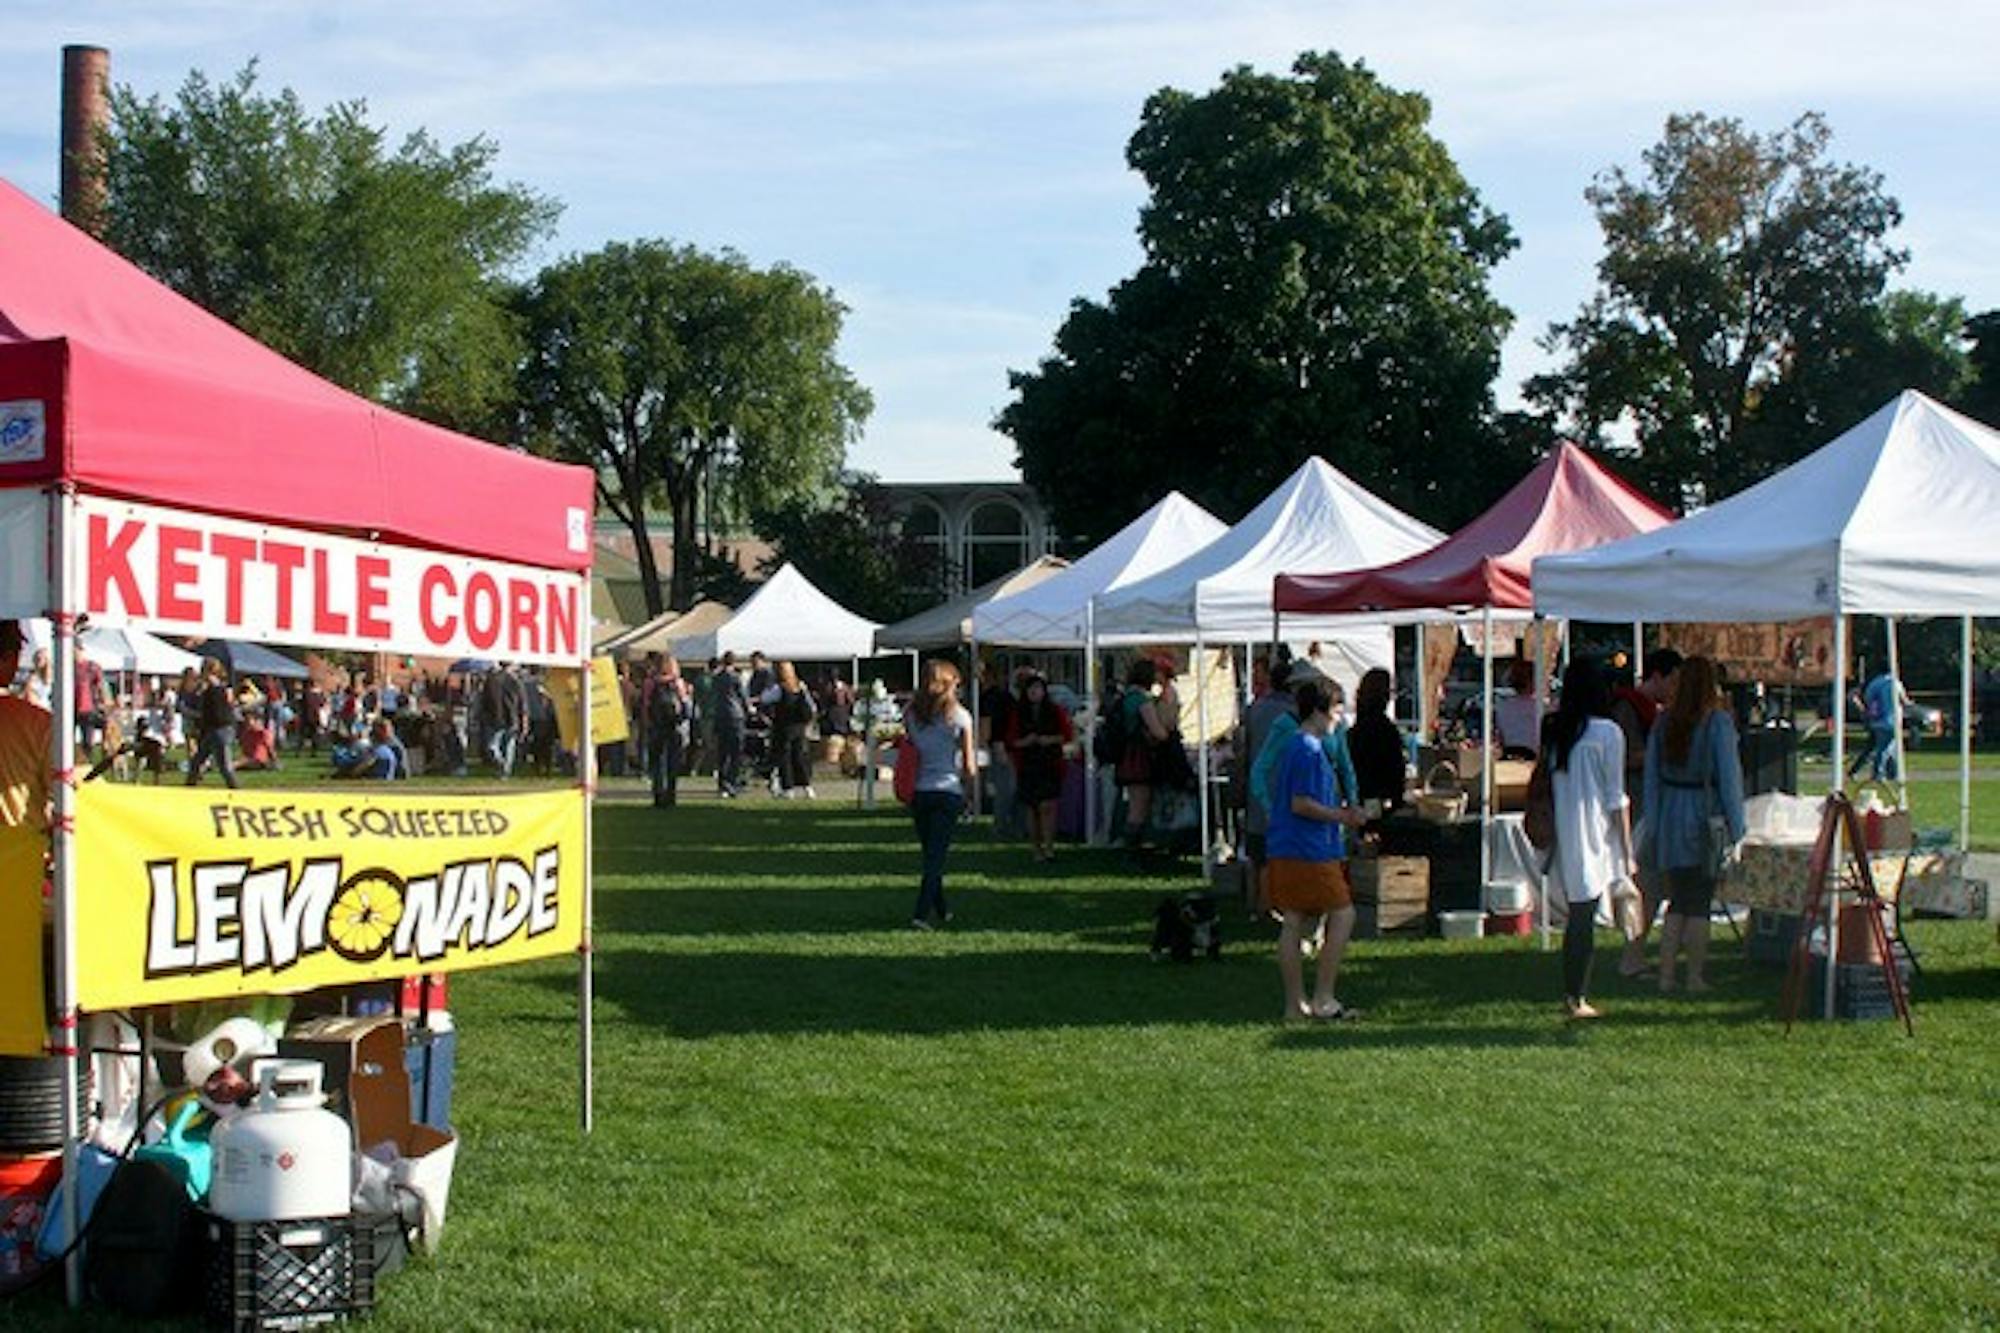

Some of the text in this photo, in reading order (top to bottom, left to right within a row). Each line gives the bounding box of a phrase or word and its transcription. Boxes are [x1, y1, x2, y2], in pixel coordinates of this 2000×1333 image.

[87, 514, 578, 654] KETTLE CORN
[211, 804, 510, 840] FRESH SQUEEZED
[144, 843, 560, 981] LEMONADE
